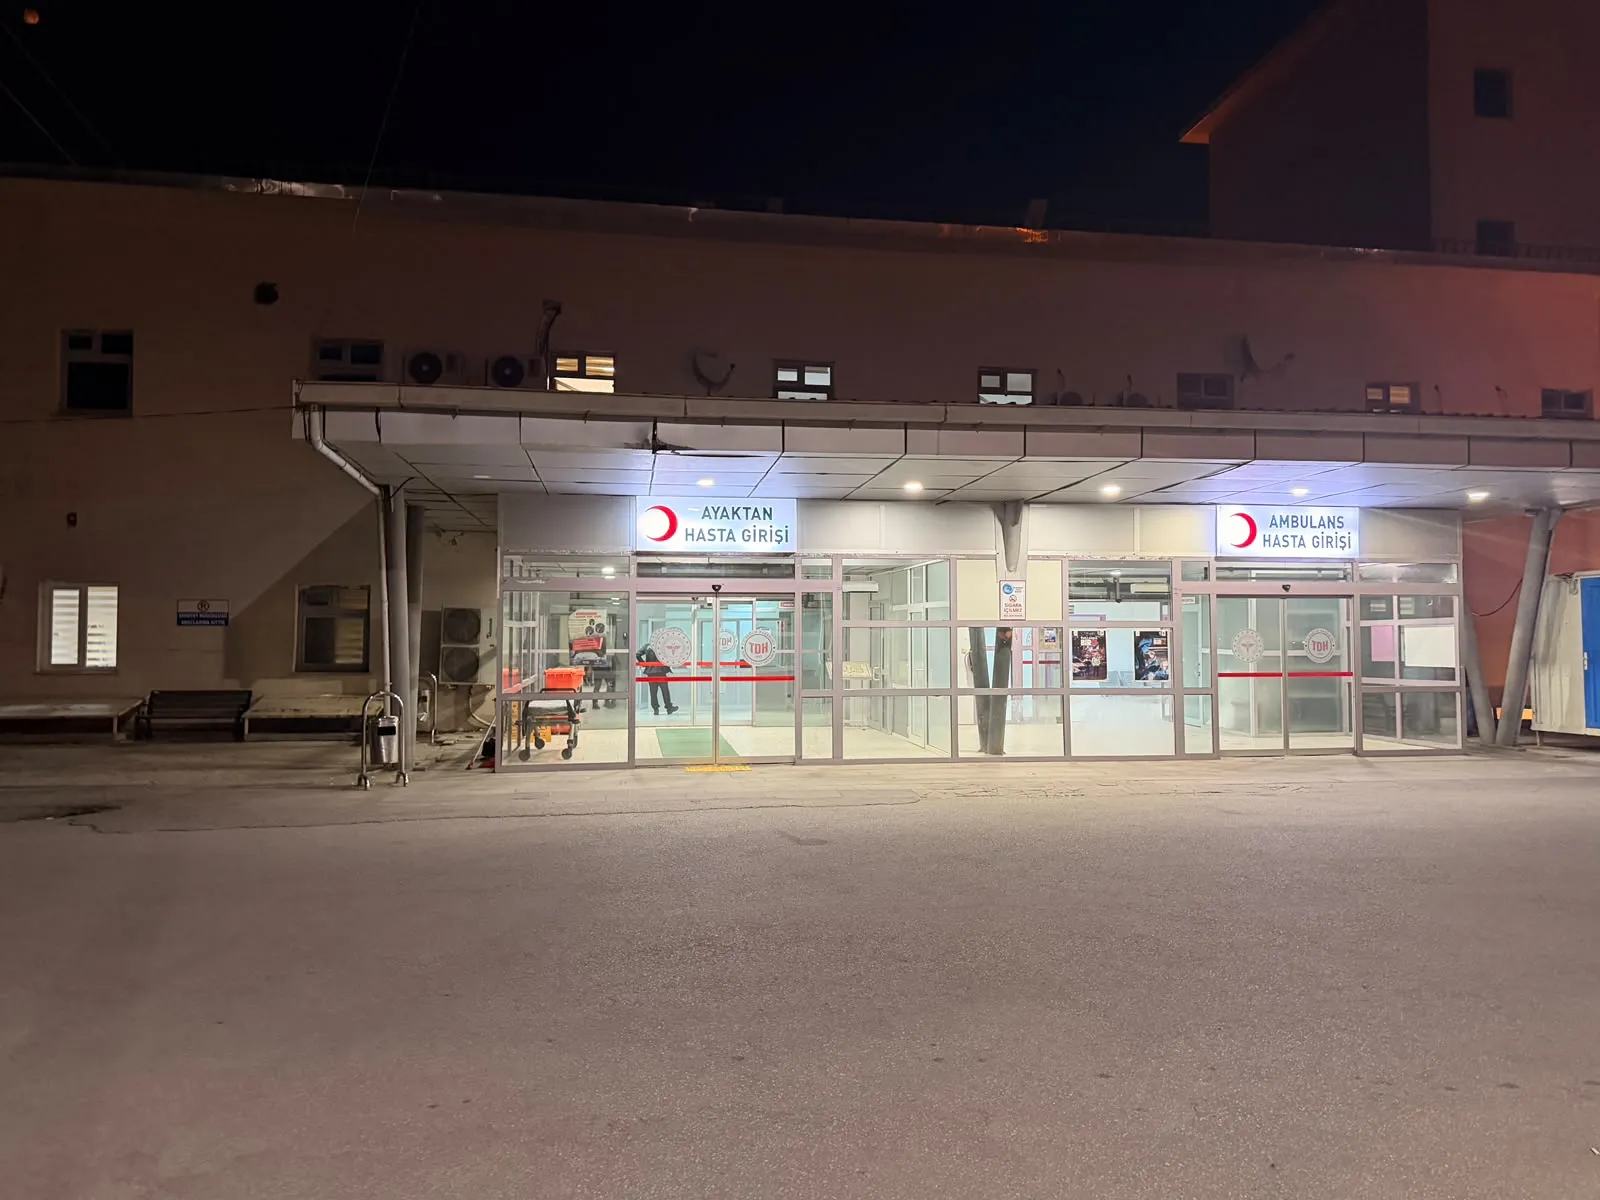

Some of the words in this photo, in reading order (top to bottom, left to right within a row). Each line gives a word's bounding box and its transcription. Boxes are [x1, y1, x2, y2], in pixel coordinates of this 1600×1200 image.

[701, 506, 773, 521] AYAKTAN
[1269, 515, 1344, 529] AMBULANS
[685, 528, 736, 542] HASTA
[742, 525, 789, 545] GİRİŞİ
[1263, 534, 1306, 548] HASTA
[1312, 532, 1352, 550] GİRİŞİ
[749, 642, 769, 655] TDH
[1312, 640, 1329, 652] TDH
